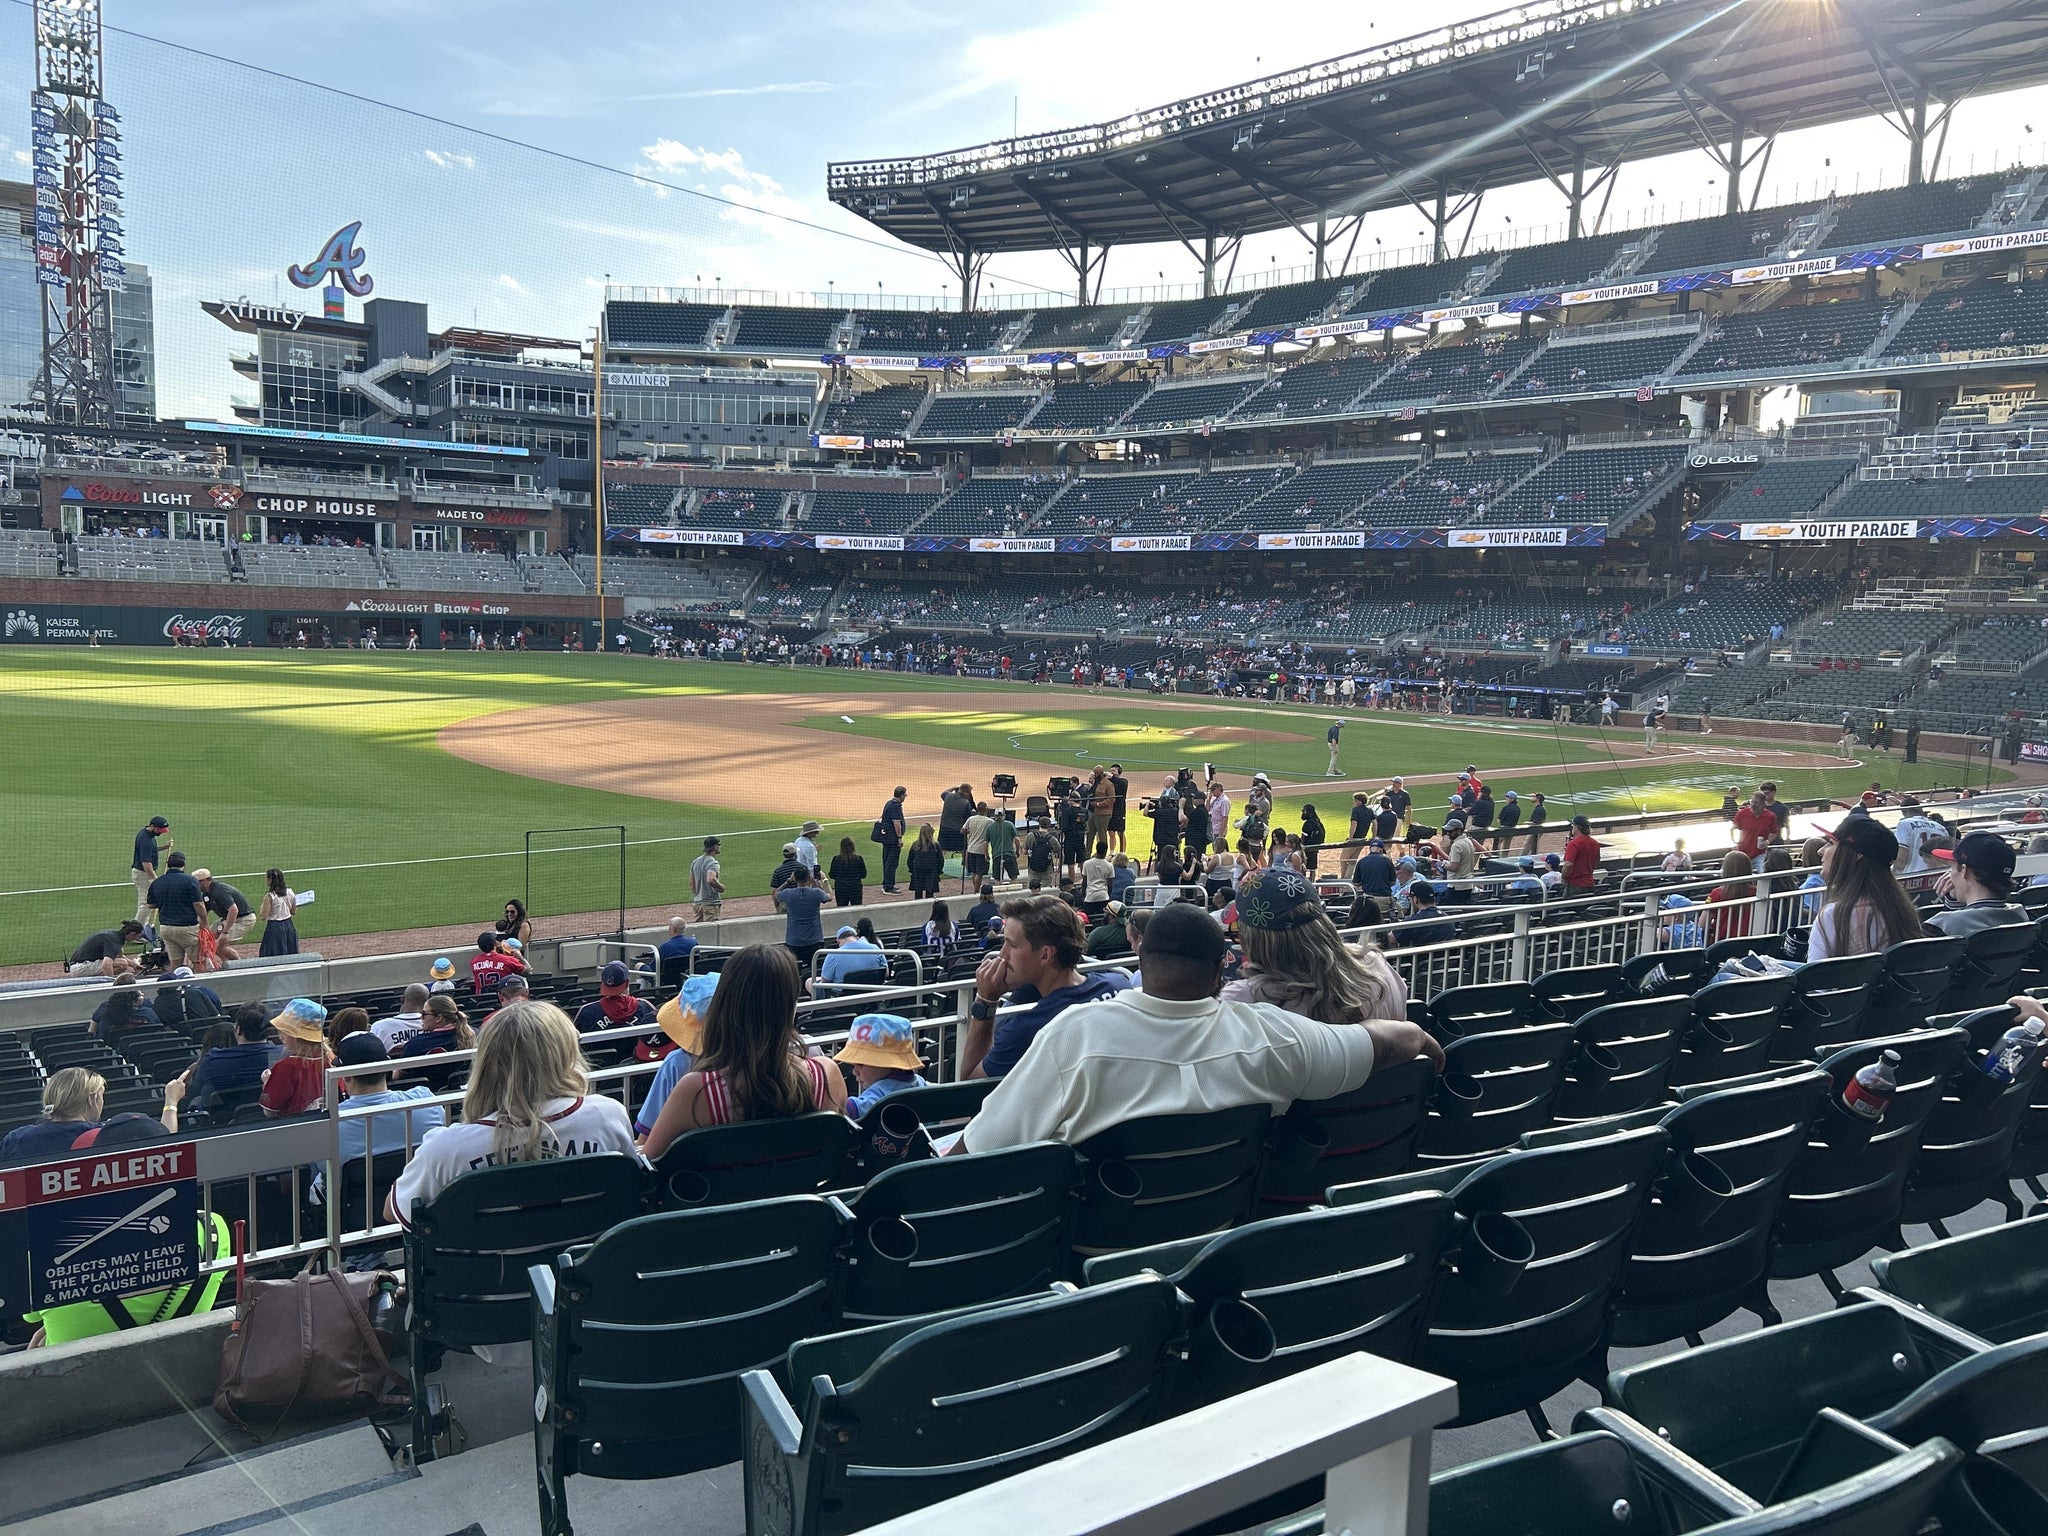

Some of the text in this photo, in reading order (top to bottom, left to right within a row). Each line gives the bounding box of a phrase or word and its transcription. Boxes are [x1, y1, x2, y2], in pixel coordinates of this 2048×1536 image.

[98, 104, 114, 117] 1997
[98, 124, 115, 136] 1999
[36, 134, 55, 146] 2000
[99, 143, 116, 156] 2001
[37, 153, 56, 166] 2002
[100, 162, 117, 174] 2003
[100, 181, 118, 193] 2005
[38, 192, 56, 204] 2010
[100, 200, 117, 212] 2012
[39, 212, 56, 224] 2013
[101, 220, 118, 231] 2018
[39, 231, 56, 243] 2019
[1968, 232, 2048, 250] YOUTH PARADE
[102, 239, 119, 251] 2020
[40, 250, 57, 262] 2021
[102, 258, 119, 269] 2022
[1767, 260, 1832, 276] YOUTH PARADE
[41, 271, 58, 282] 2023
[103, 276, 120, 288] 2024
[1594, 283, 1654, 299] YOUTH PARADE
[220, 295, 307, 330] xfinity
[1448, 304, 1496, 318] YOUTH PARADE
[1320, 322, 1365, 334] YOUTH PARADE
[1209, 337, 1245, 349] YOUTH PARADE
[870, 357, 916, 366] YOUTH PARADE
[987, 356, 1026, 365] YOUTH PARADE
[1101, 350, 1147, 361] YOUTH PARADE
[623, 375, 666, 386] MILNER
[1637, 386, 1653, 401] 21
[1402, 406, 1415, 420] 10
[874, 439, 904, 449] 6:25 PM
[1709, 455, 1758, 465] LEXUS
[85, 483, 192, 505] Coors LIGHT
[257, 498, 376, 516] CHOP HOUSE
[436, 510, 528, 524] MADE TO Chill
[1800, 522, 1909, 538] YOUTH PARADE
[676, 533, 739, 543] YOUTH PARADE
[848, 538, 901, 548] YOUTH PARADE
[1138, 538, 1187, 548] YOUTH PARADE
[1294, 534, 1360, 546] YOUTH PARADE
[1488, 531, 1562, 543] YOUTH PARADE
[1003, 541, 1052, 550] YOUTH PARADE
[360, 599, 396, 612] Coors
[398, 604, 428, 612] LIGHT
[434, 603, 469, 613] BELOW
[482, 605, 509, 614] CHOP
[46, 619, 79, 627] KAISER
[46, 629, 114, 638] PERMANNTE
[2033, 745, 2048, 756] SHO
[469, 1140, 598, 1170] FEMAN
[42, 1167, 81, 1195] BE
[91, 1151, 182, 1187] ALERT
[46, 1244, 185, 1278] OBJECTS MAY LEAVE
[50, 1256, 182, 1290] THE PLAYING FIELD
[44, 1267, 189, 1304] & MAY CAUSE INJURY
